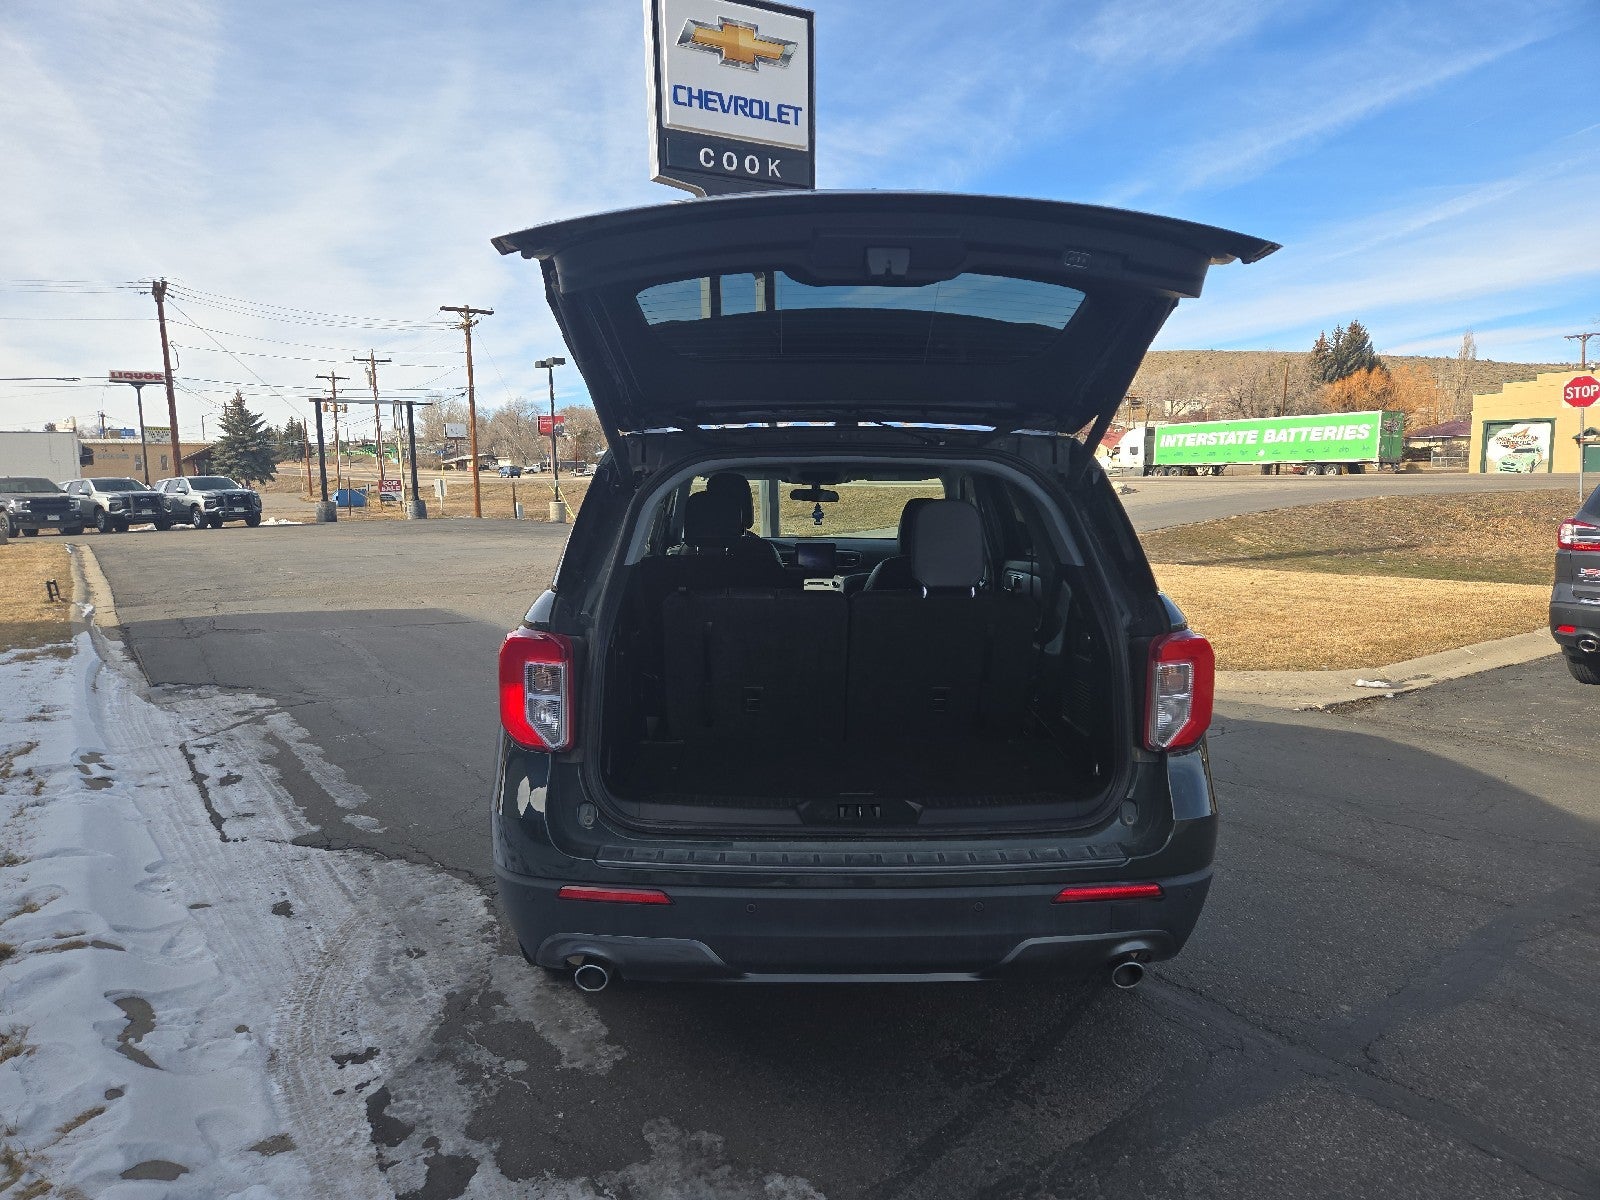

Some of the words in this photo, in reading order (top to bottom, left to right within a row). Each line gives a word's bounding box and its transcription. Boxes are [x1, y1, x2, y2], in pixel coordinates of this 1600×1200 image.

[672, 84, 802, 126] CHEVROLET
[700, 147, 782, 178] COOK
[110, 371, 164, 381] LIQUOR
[1565, 384, 1600, 400] STOP
[1160, 430, 1259, 448] INTERSTATE
[1263, 423, 1371, 444] BATTERIES
